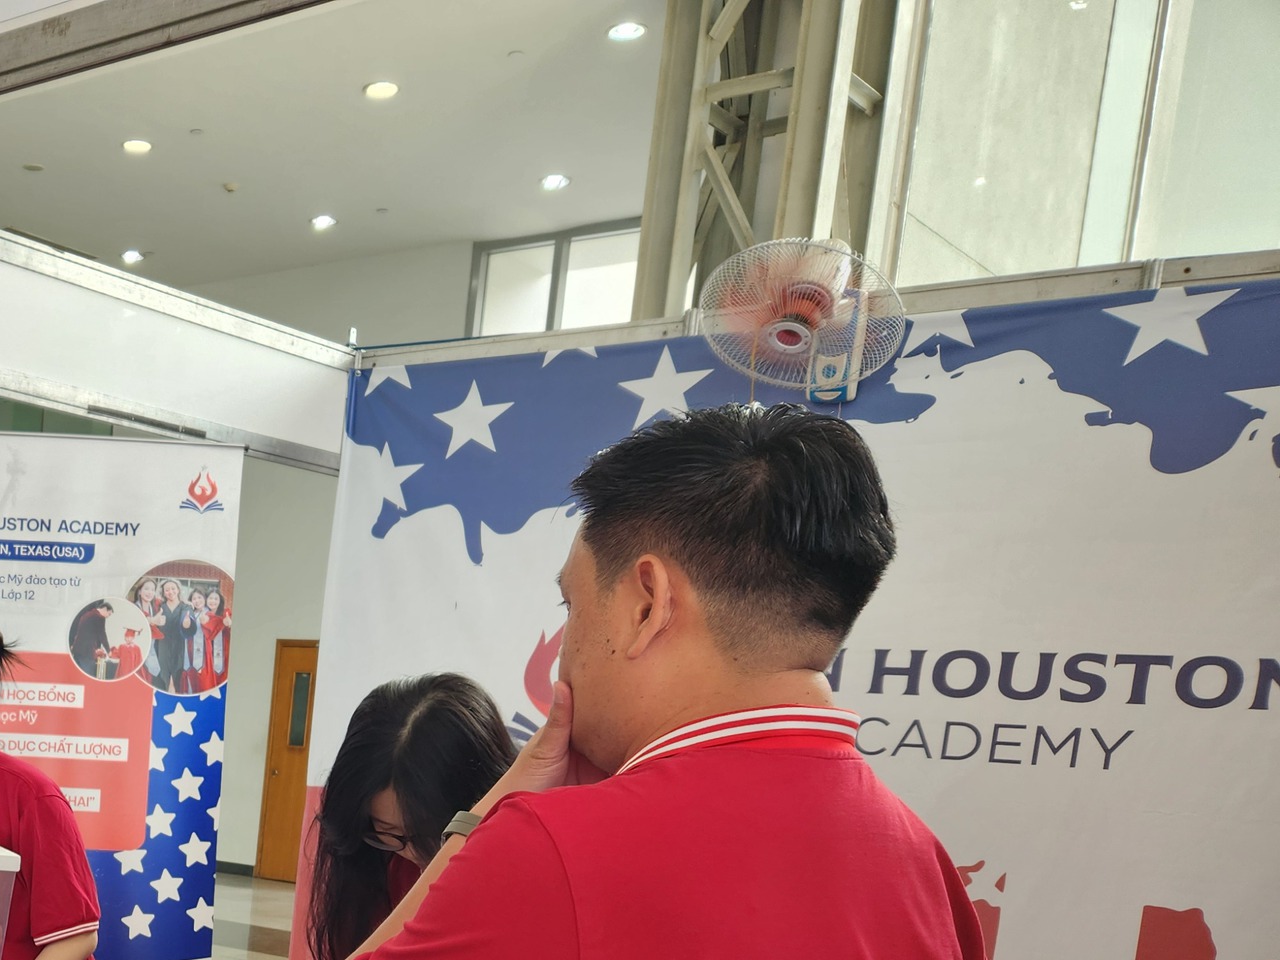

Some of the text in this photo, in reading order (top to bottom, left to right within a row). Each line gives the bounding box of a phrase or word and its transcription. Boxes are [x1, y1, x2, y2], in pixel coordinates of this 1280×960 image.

[57, 519, 141, 537] ACADEMY
[13, 544, 51, 557] TEXAS
[52, 545, 85, 560] (USA)
[7, 572, 24, 586] Mỹ
[25, 574, 47, 586] đào
[49, 576, 67, 588] tạo
[1, 588, 22, 601] Lớp
[24, 590, 35, 600] 12
[7, 689, 36, 704] HỌC
[38, 685, 76, 703] BỔNG
[19, 709, 38, 725] Mỹ
[8, 740, 36, 755] DỤC
[38, 737, 73, 754] CHẤT
[76, 742, 122, 759] LƯỢNG
[855, 716, 1135, 770] CADEMY
